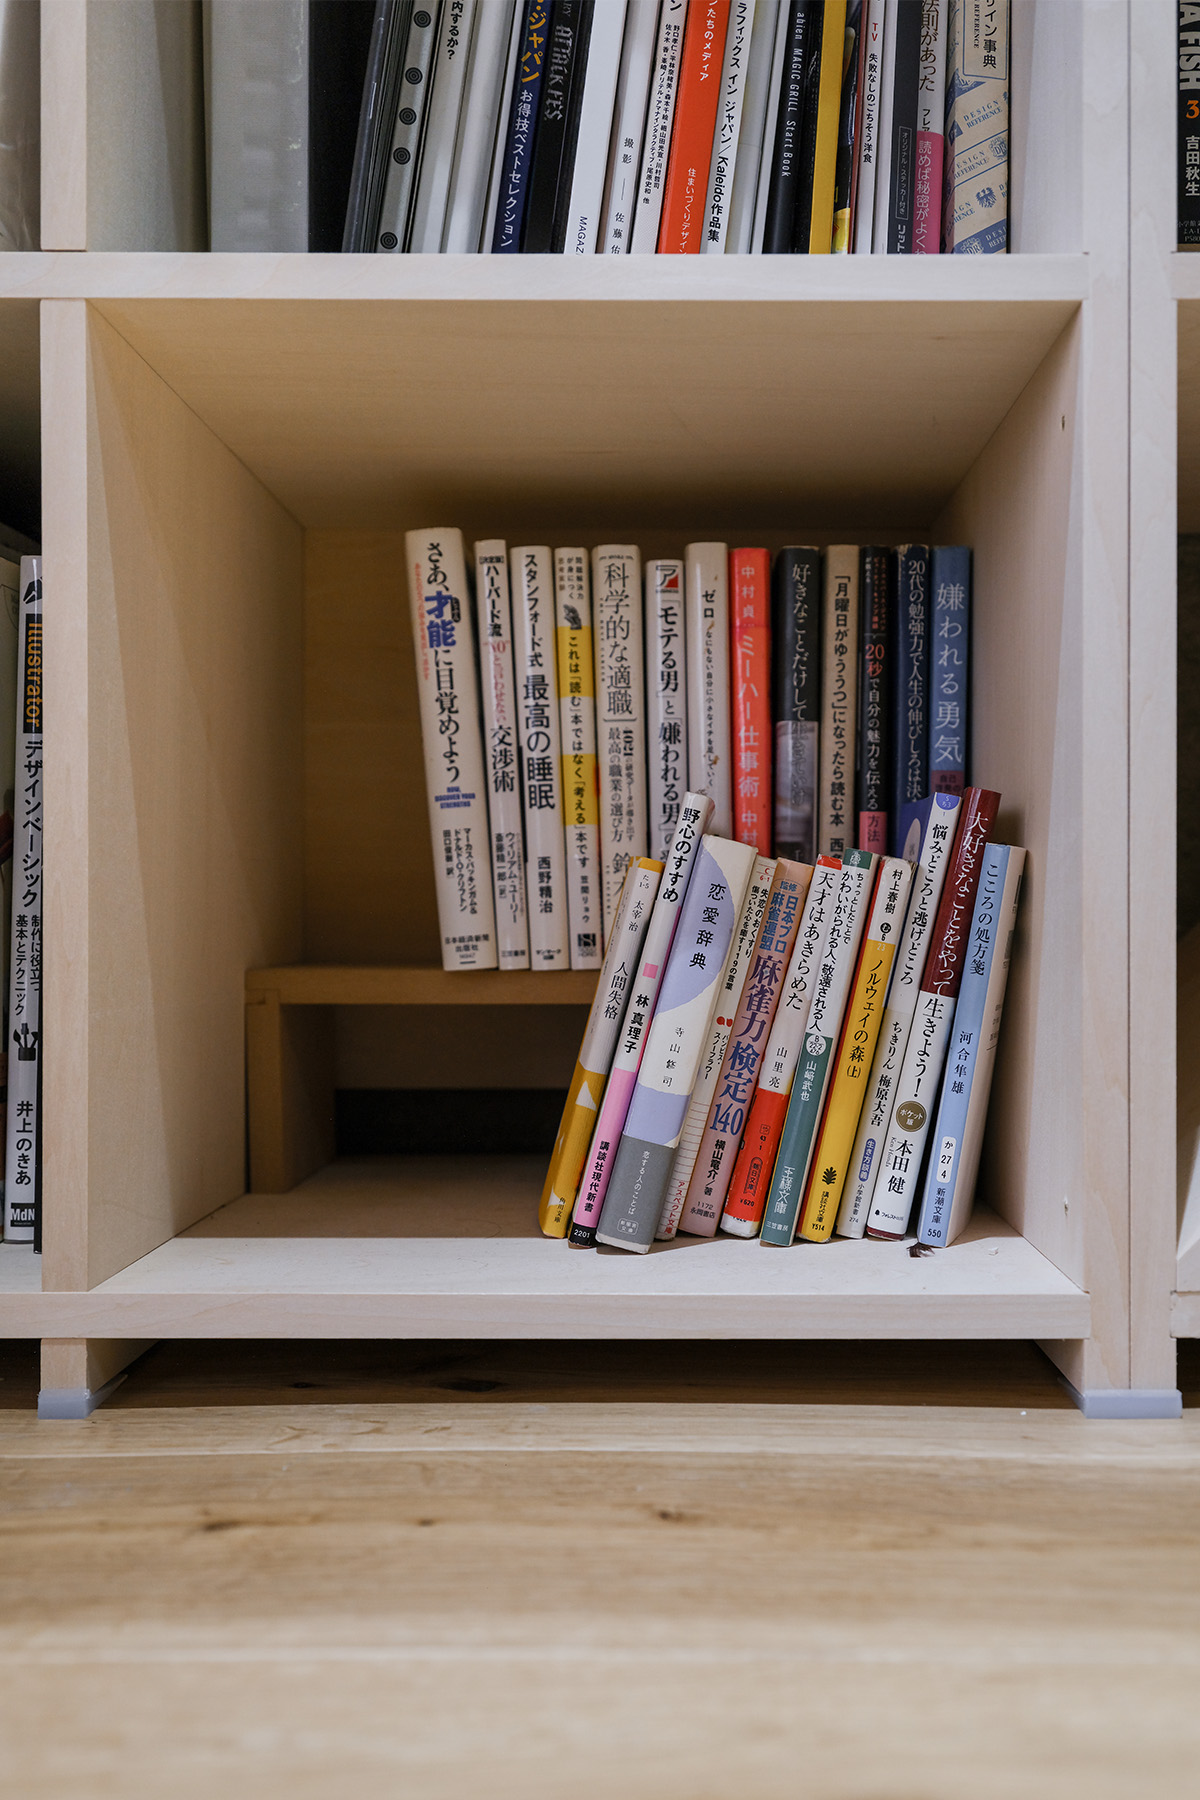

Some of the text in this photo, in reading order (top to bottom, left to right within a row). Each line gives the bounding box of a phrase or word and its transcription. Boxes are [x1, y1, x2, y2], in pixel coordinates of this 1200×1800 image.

[447, 0, 464, 60] 内するか?
[521, 0, 546, 83] ・ジャパン
[794, 12, 805, 40] abien
[791, 48, 803, 80] MAGIC
[787, 84, 799, 112] GRILL
[963, 99, 1000, 122] DESIGN
[966, 106, 1003, 129] REFERENCE
[780, 152, 793, 178] Book
[956, 149, 986, 169] ESIGN
[702, 589, 717, 619] ゼロ
[424, 542, 461, 784] さあ、才能に目覚めよう
[603, 562, 633, 716] 科学的な適職
[523, 554, 556, 810] スタンフォード式 最高の睡眠
[906, 559, 926, 802] 20代の勉強力で人生の伸びしろは決
[934, 582, 965, 764] 嫌われる勇気
[490, 724, 515, 793] 交渉術
[538, 856, 553, 914] 西野精治
[662, 807, 702, 903] 野心のすすめ
[779, 880, 798, 892] 監修
[759, 891, 784, 952] 麻雀連盟
[842, 872, 864, 944] ちょっとしたことで
[884, 868, 903, 915] 村上春樹
[900, 823, 949, 985] 悩みどころと逃げどころ
[970, 863, 999, 976] こころの処方箋
[688, 882, 727, 970] 恋愛辞典
[774, 894, 799, 954] 日本プロ
[785, 870, 836, 1011] 天才はあきらめた
[15, 914, 29, 1016] 基本とテクニック
[603, 961, 629, 1021] 人間失格
[662, 1026, 685, 1088] 寺山修司
[870, 1021, 903, 1127] ちきりん 梅原大吾
[950, 1030, 974, 1095] 河合隼雄
[15, 1099, 34, 1187] 井上のきあ
[584, 1140, 611, 1213] 講談社現代新書
[931, 1187, 946, 1224] 新潮文庫
[573, 1228, 590, 1239] 2201
[927, 1228, 942, 1239] 550
